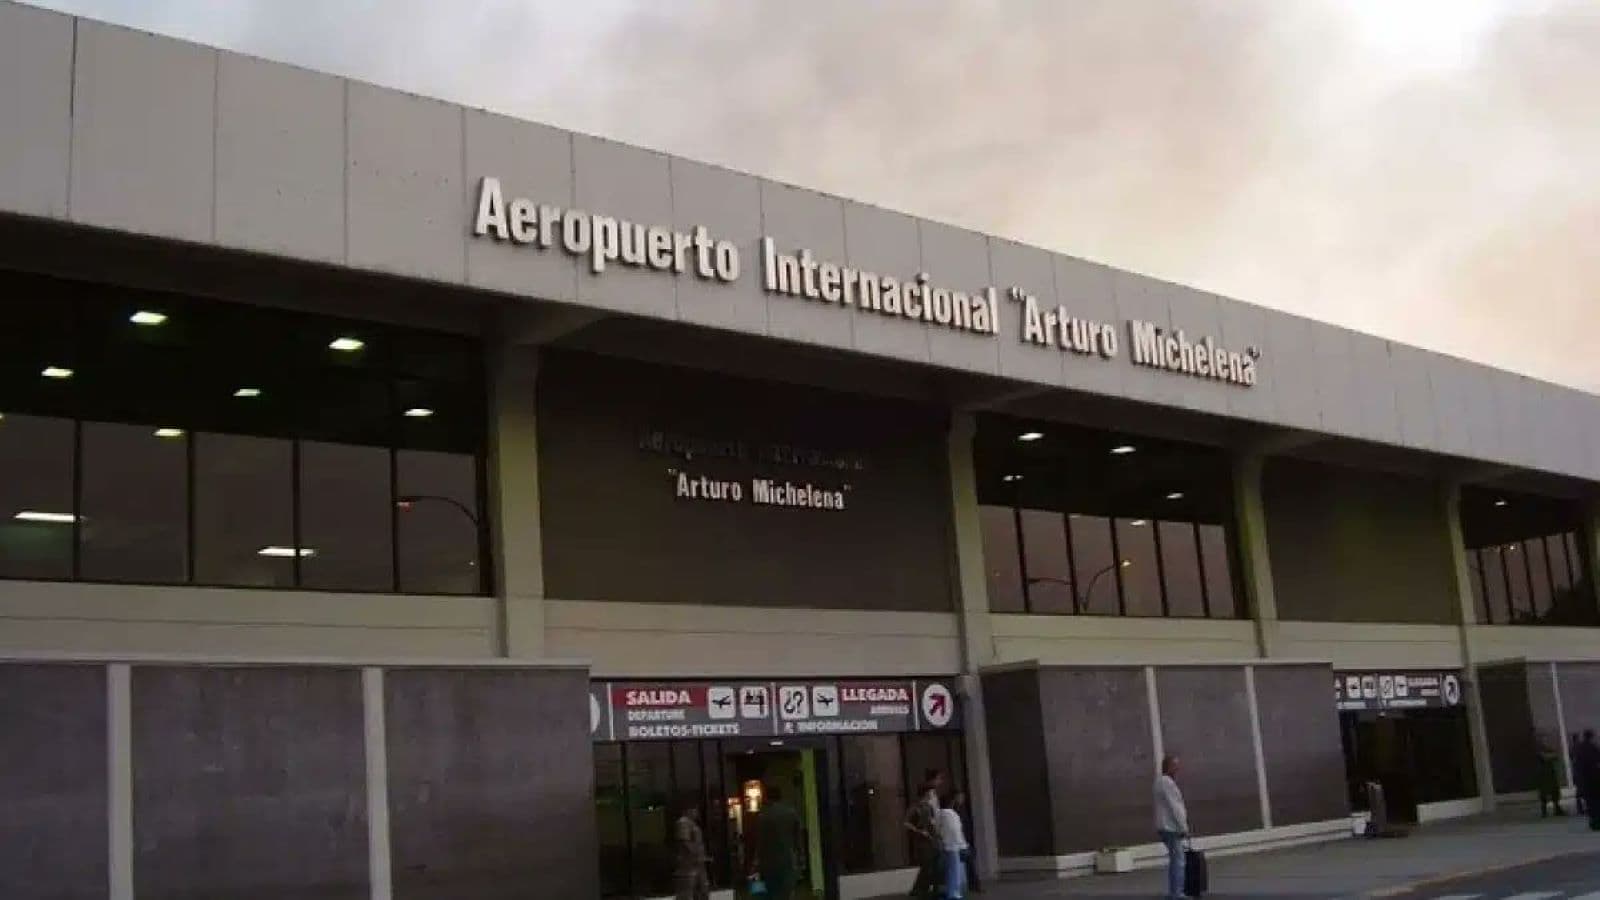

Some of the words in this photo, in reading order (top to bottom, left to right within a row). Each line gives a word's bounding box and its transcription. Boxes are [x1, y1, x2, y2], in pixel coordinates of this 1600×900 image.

[475, 176, 740, 282] Aeropuerto
[762, 235, 998, 335] Internacional
[626, 690, 691, 706] SALIDA
[841, 688, 909, 701] LLEGADA
